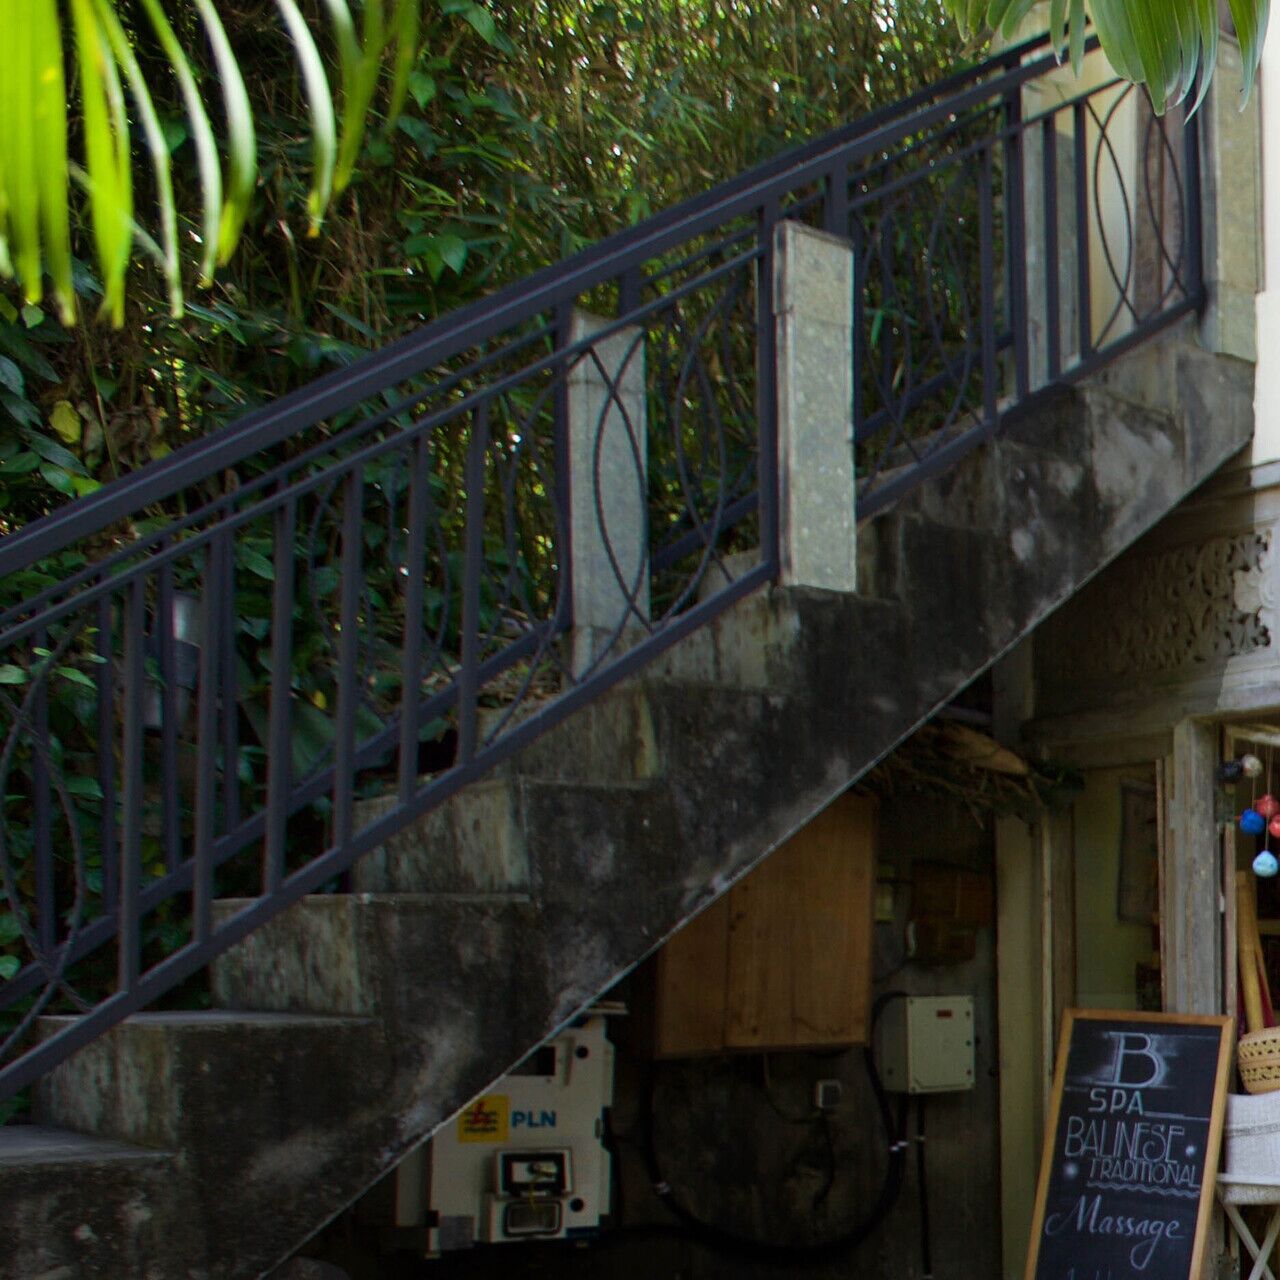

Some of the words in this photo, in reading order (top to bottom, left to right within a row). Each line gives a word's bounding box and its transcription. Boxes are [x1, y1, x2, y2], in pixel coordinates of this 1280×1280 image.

[1106, 1031, 1162, 1088] B
[511, 1110, 557, 1128] PLN
[1087, 1088, 1144, 1115] SPA
[1065, 1115, 1186, 1164] BALINESE
[1089, 1158, 1200, 1189] TRADITIONAL
[1044, 1194, 1187, 1270] Massage
